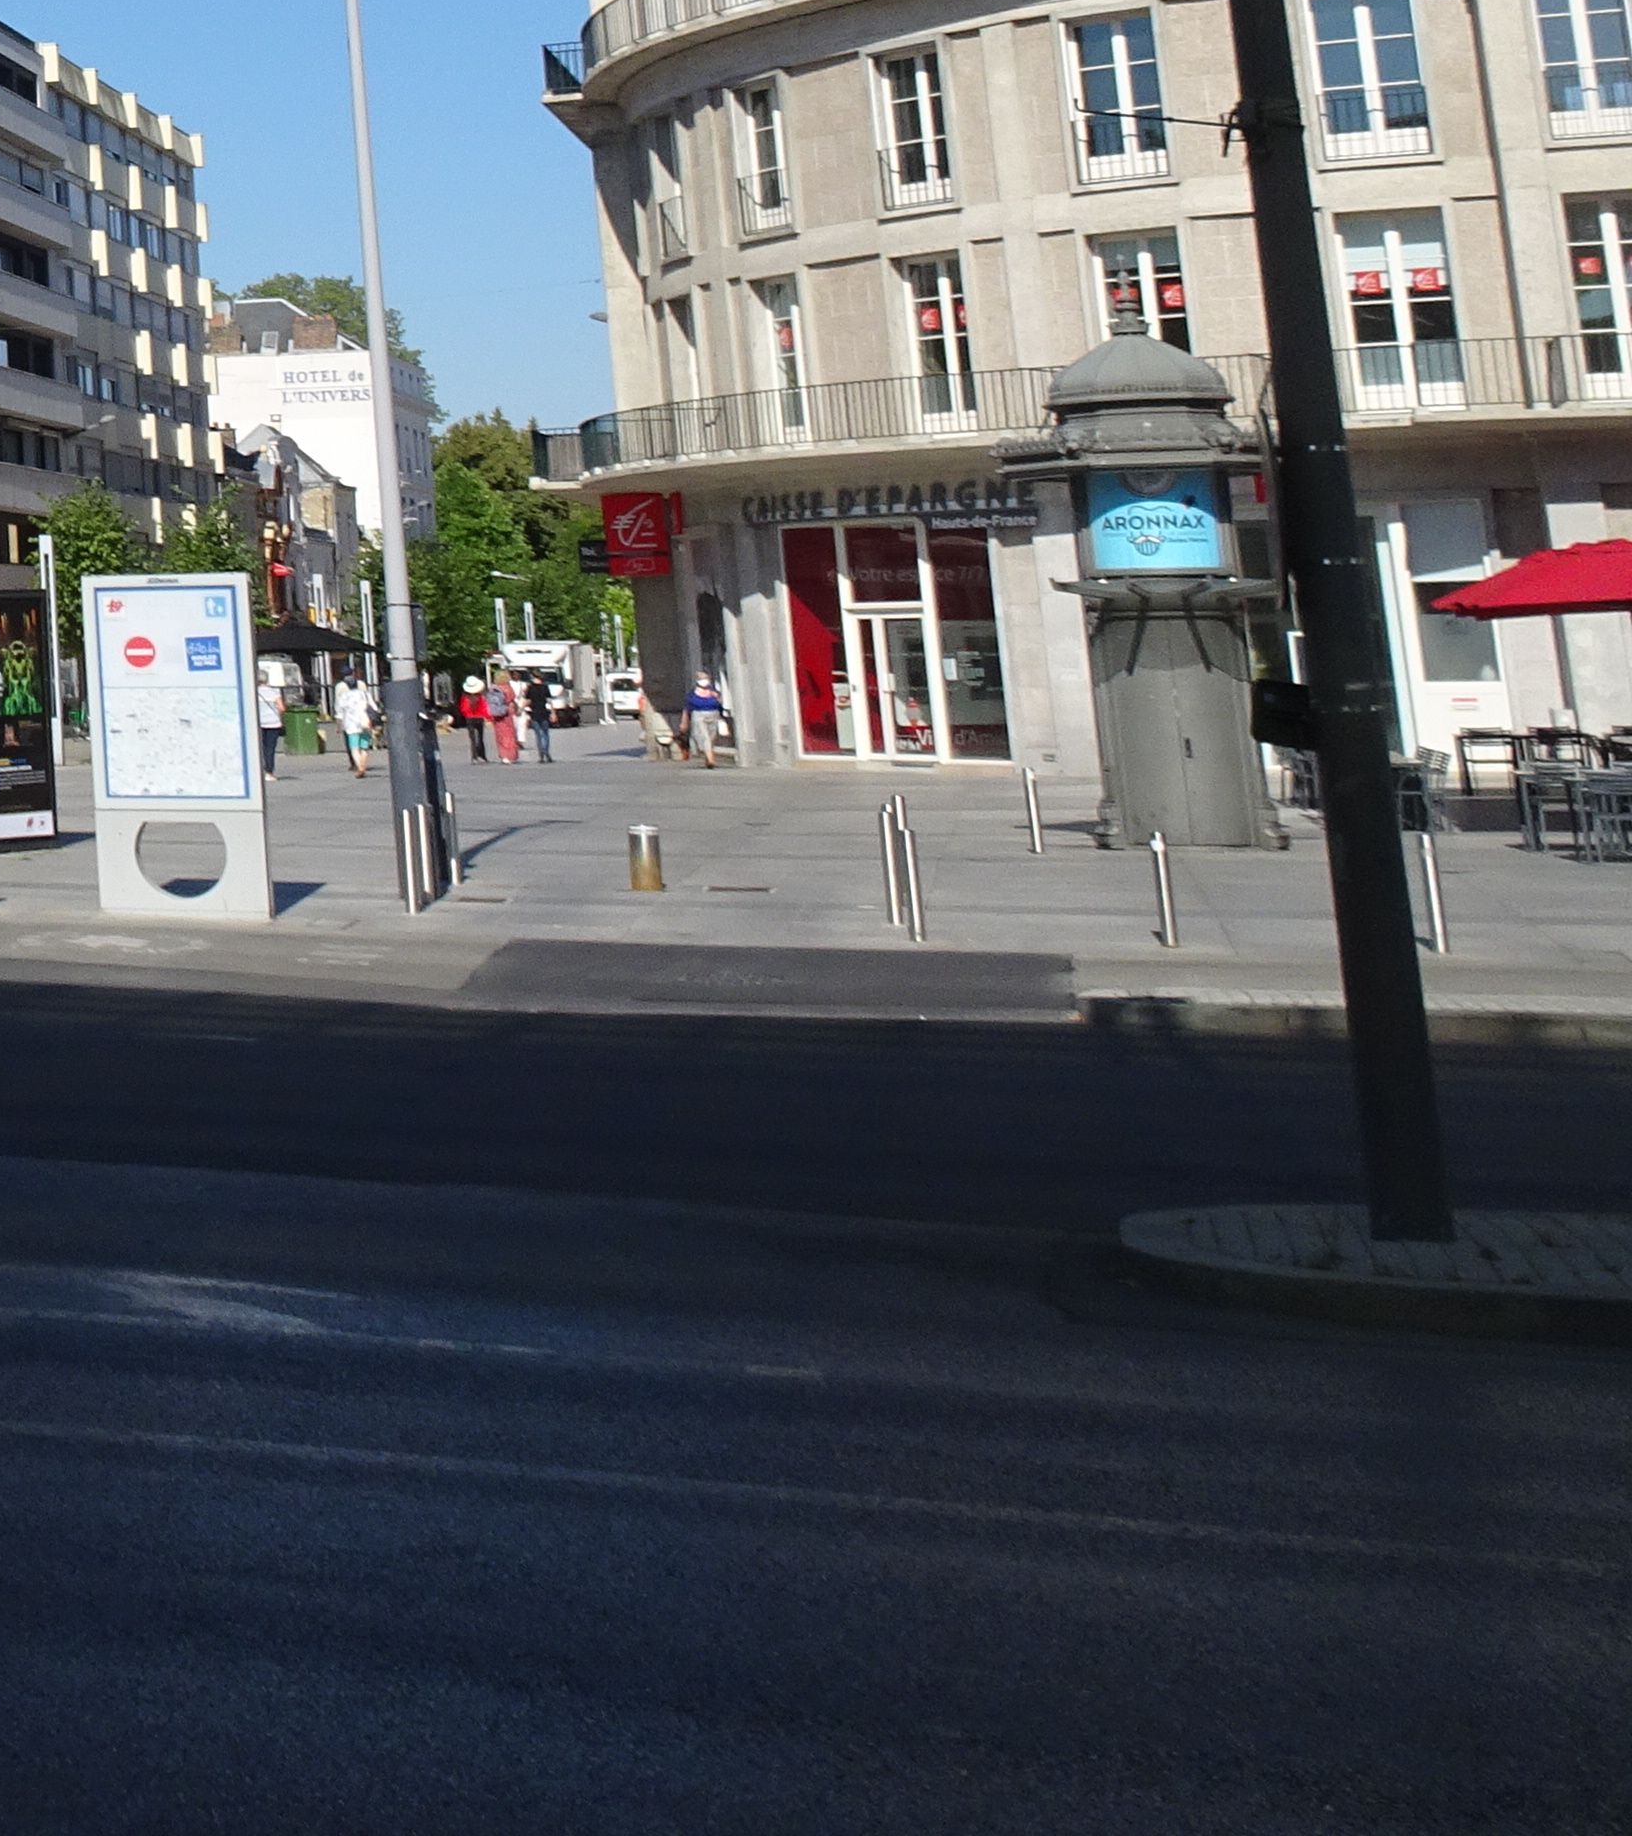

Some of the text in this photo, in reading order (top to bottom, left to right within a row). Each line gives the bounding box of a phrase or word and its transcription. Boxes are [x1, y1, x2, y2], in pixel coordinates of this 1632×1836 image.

[282, 370, 365, 384] HOTEL de
[282, 388, 372, 405] L'UNIVERS
[742, 477, 1035, 524] CAISSE D'EPARGNE
[931, 515, 1038, 529] Hauts-de-France
[1102, 515, 1206, 532] ARONNAX
